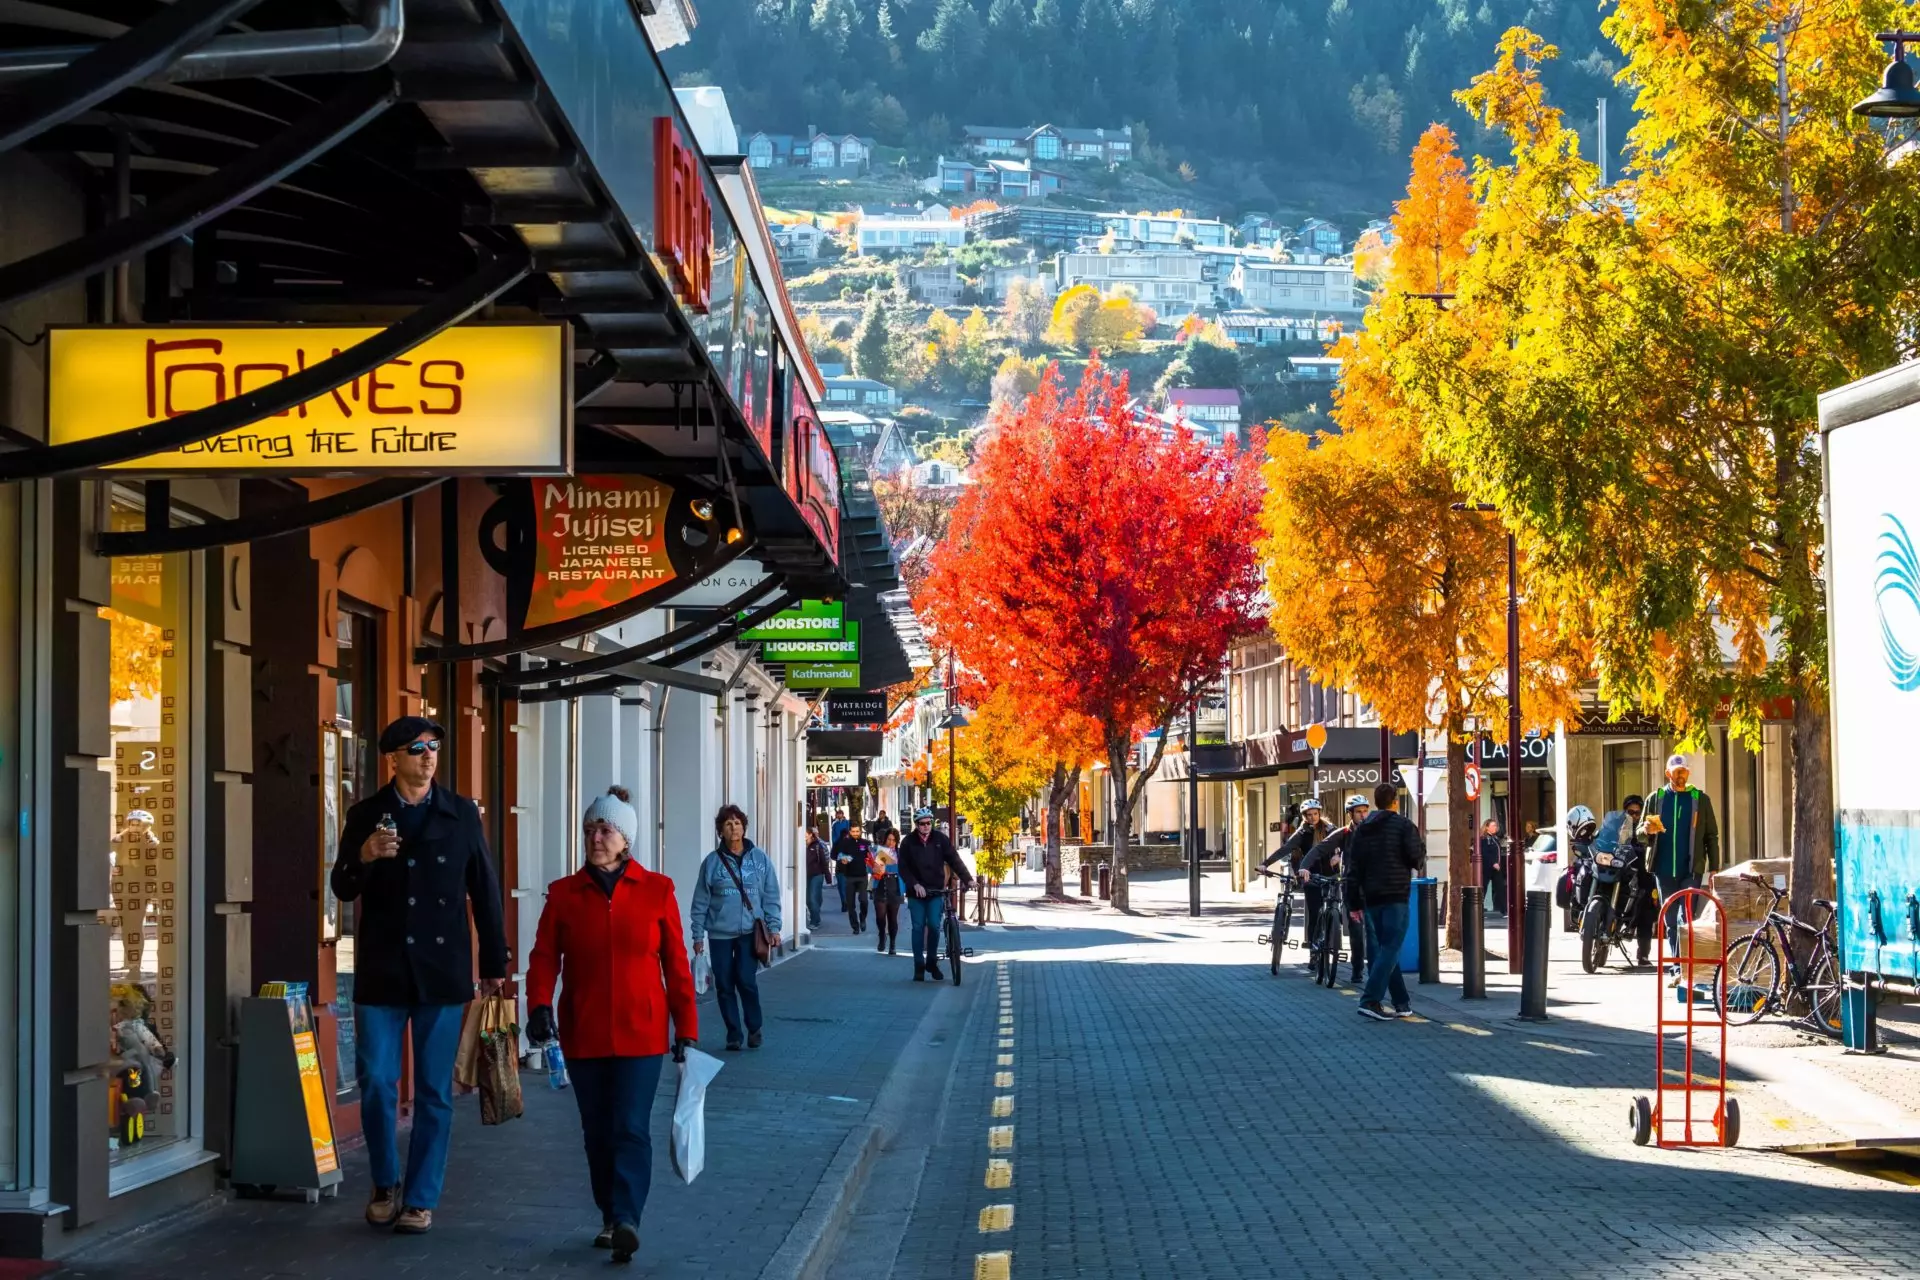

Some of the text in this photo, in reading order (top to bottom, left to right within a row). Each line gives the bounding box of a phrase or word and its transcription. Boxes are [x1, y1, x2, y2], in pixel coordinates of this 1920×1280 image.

[544, 482, 660, 510] Minami
[552, 513, 652, 542] Jujisei
[562, 544, 649, 556] LICENSED
[559, 556, 653, 568] JAPANESE
[547, 569, 665, 581] RESTAURANT
[765, 641, 856, 653] LIQUORSTORE
[792, 669, 852, 679] Kathmandu
[1317, 769, 1400, 784] GLASSOS
